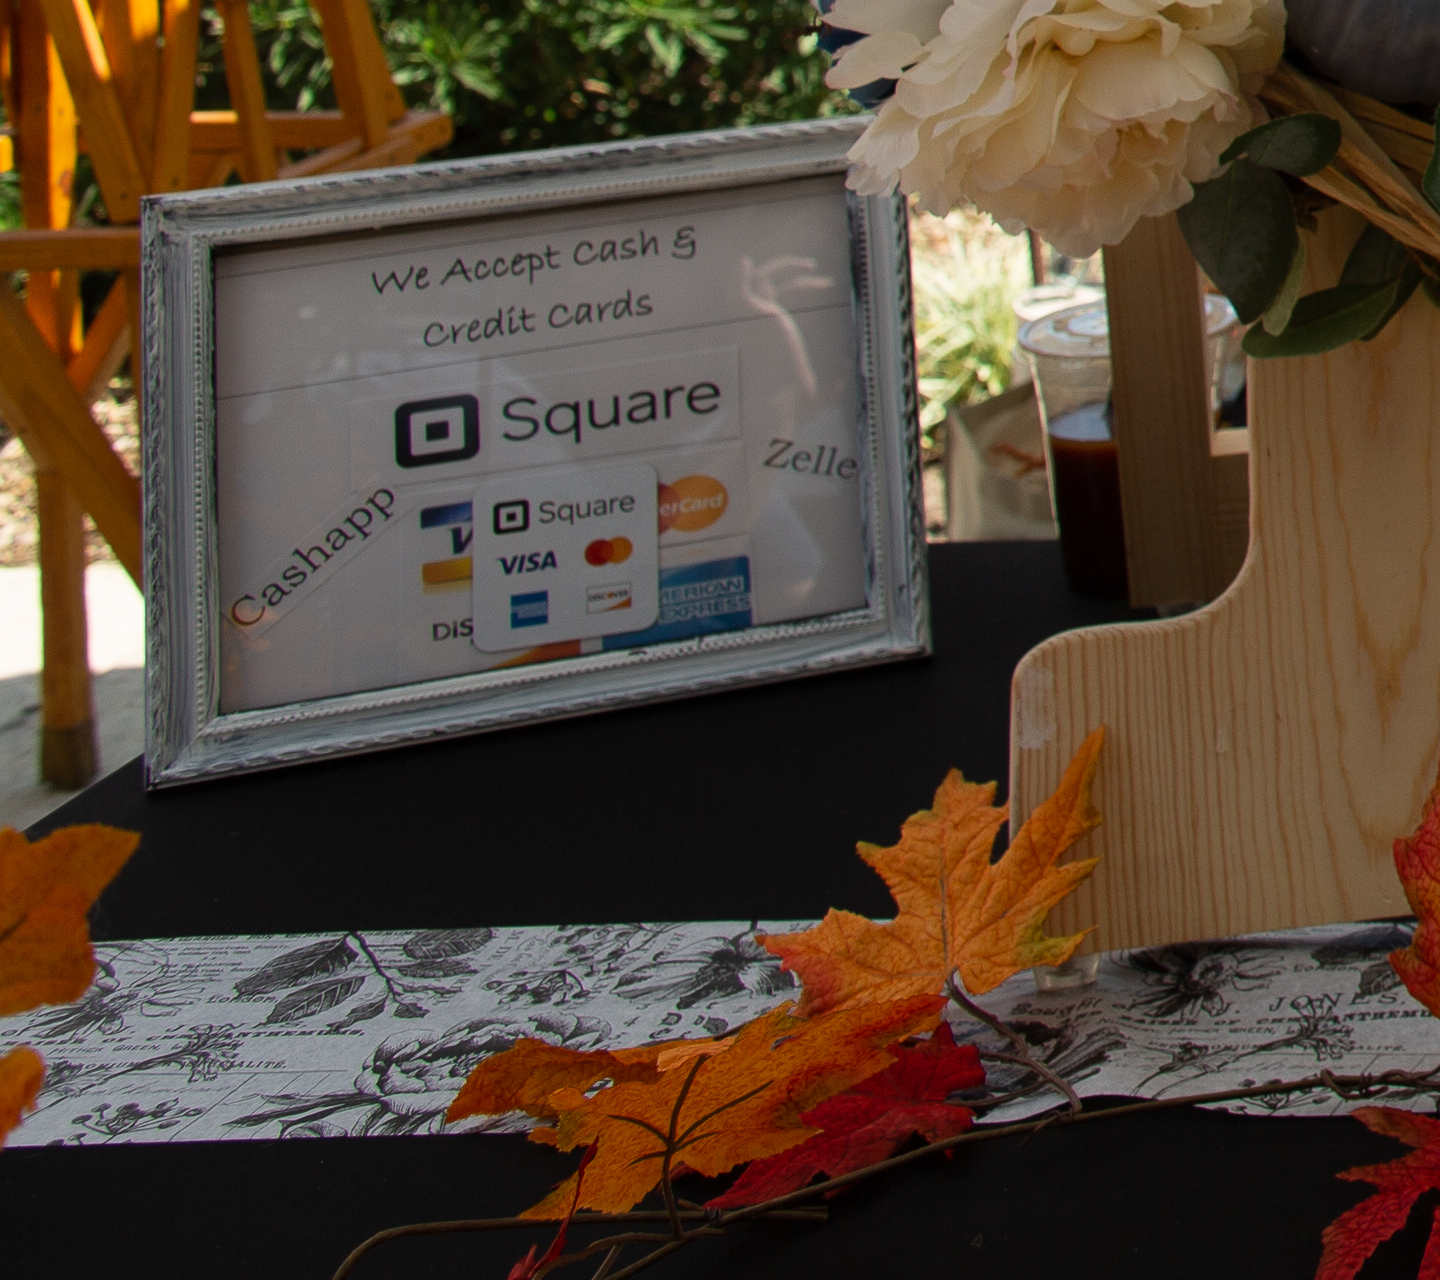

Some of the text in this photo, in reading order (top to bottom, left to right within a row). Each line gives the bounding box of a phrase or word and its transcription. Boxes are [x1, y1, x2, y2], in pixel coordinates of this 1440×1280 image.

[371, 263, 431, 295] We
[440, 244, 562, 285] Accept
[573, 230, 660, 266] Cash
[423, 289, 654, 348] Credit Cards
[501, 380, 722, 444] Square
[763, 438, 860, 480] Zelle
[537, 493, 636, 526] Square
[231, 487, 395, 627] Cashapp
[497, 550, 558, 576] VISA
